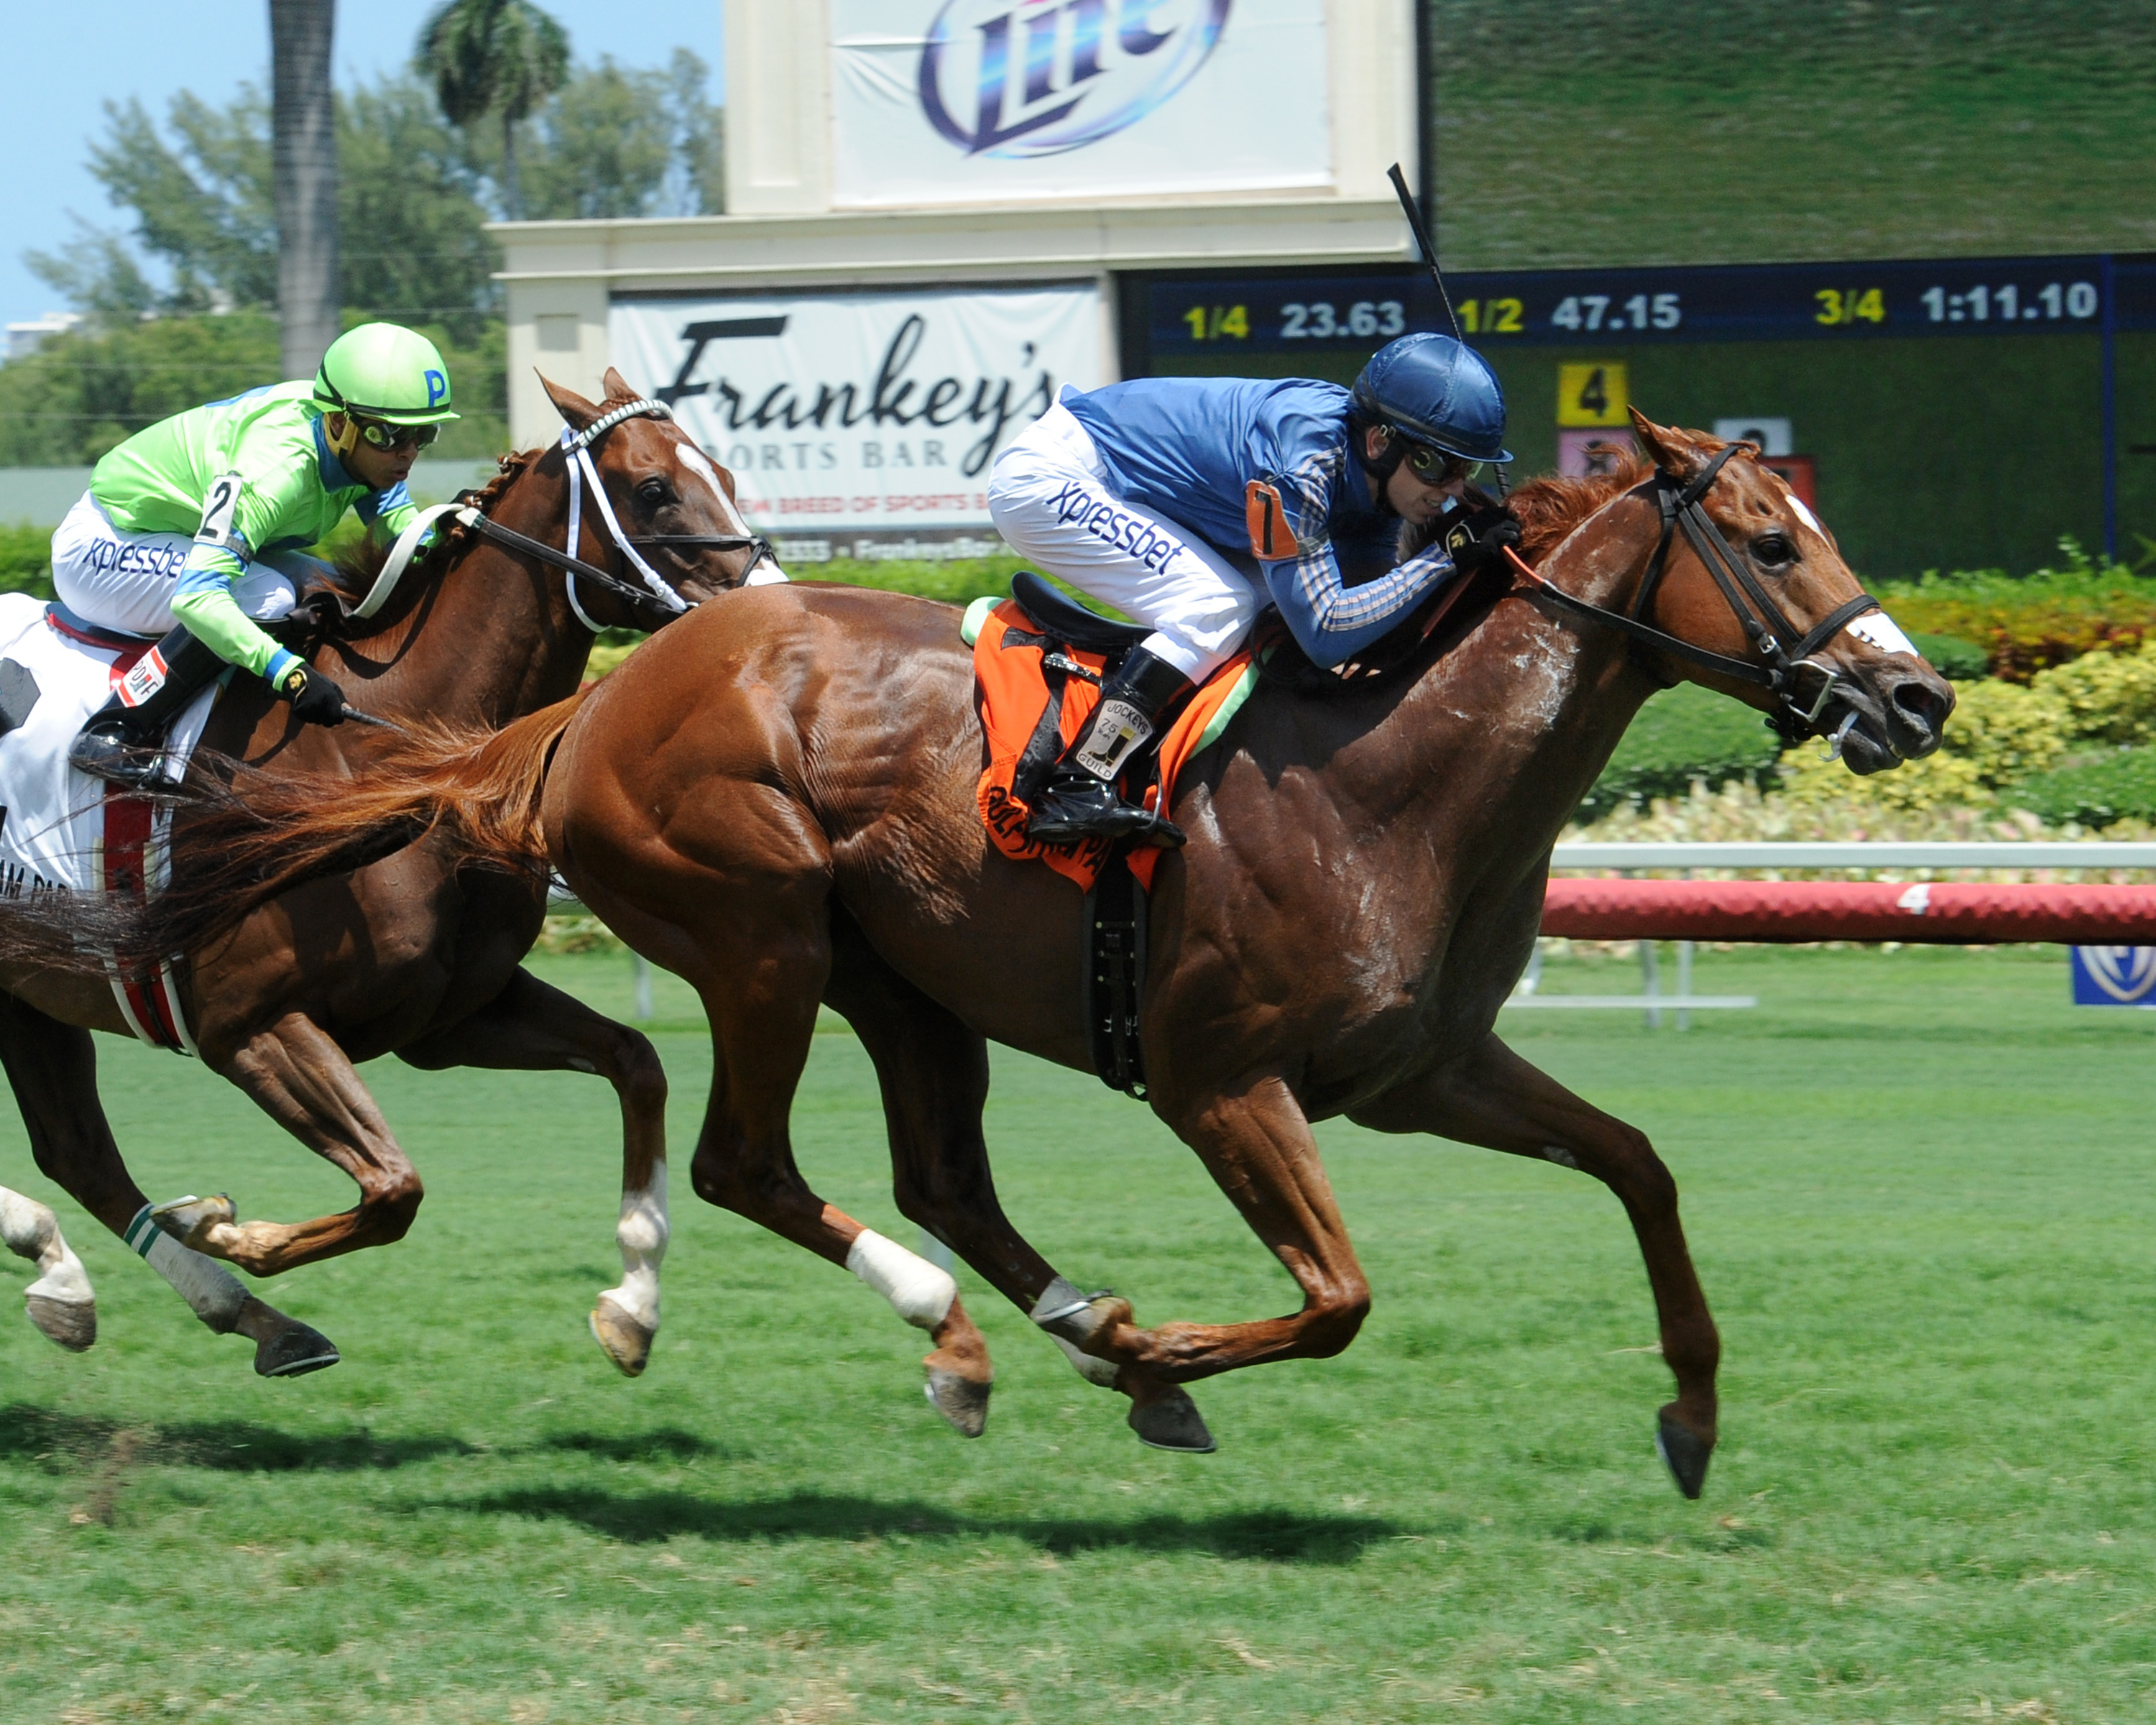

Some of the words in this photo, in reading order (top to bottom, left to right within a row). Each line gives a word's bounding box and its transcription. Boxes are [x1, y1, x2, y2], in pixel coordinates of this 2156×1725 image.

[1184, 305, 1249, 339] 1/4
[1281, 300, 1406, 338] 23.63
[1457, 297, 1524, 333] 1/2
[1552, 293, 1680, 330] 47.15
[1815, 289, 1885, 326] 3/4
[1922, 282, 2096, 321] 1:11.10
[423, 369, 445, 408] P
[654, 314, 1054, 477] Frankey's
[1579, 367, 1609, 418] 4
[703, 441, 838, 472] ORTS
[861, 439, 949, 469] BAR
[197, 481, 232, 540] 2
[853, 496, 878, 513] OF
[885, 494, 968, 512] SPORTS
[1102, 717, 1119, 734] 75
[1107, 704, 1149, 735] JOCKEYS
[1078, 753, 1112, 778] GUILD
[1897, 883, 1930, 916] 4
